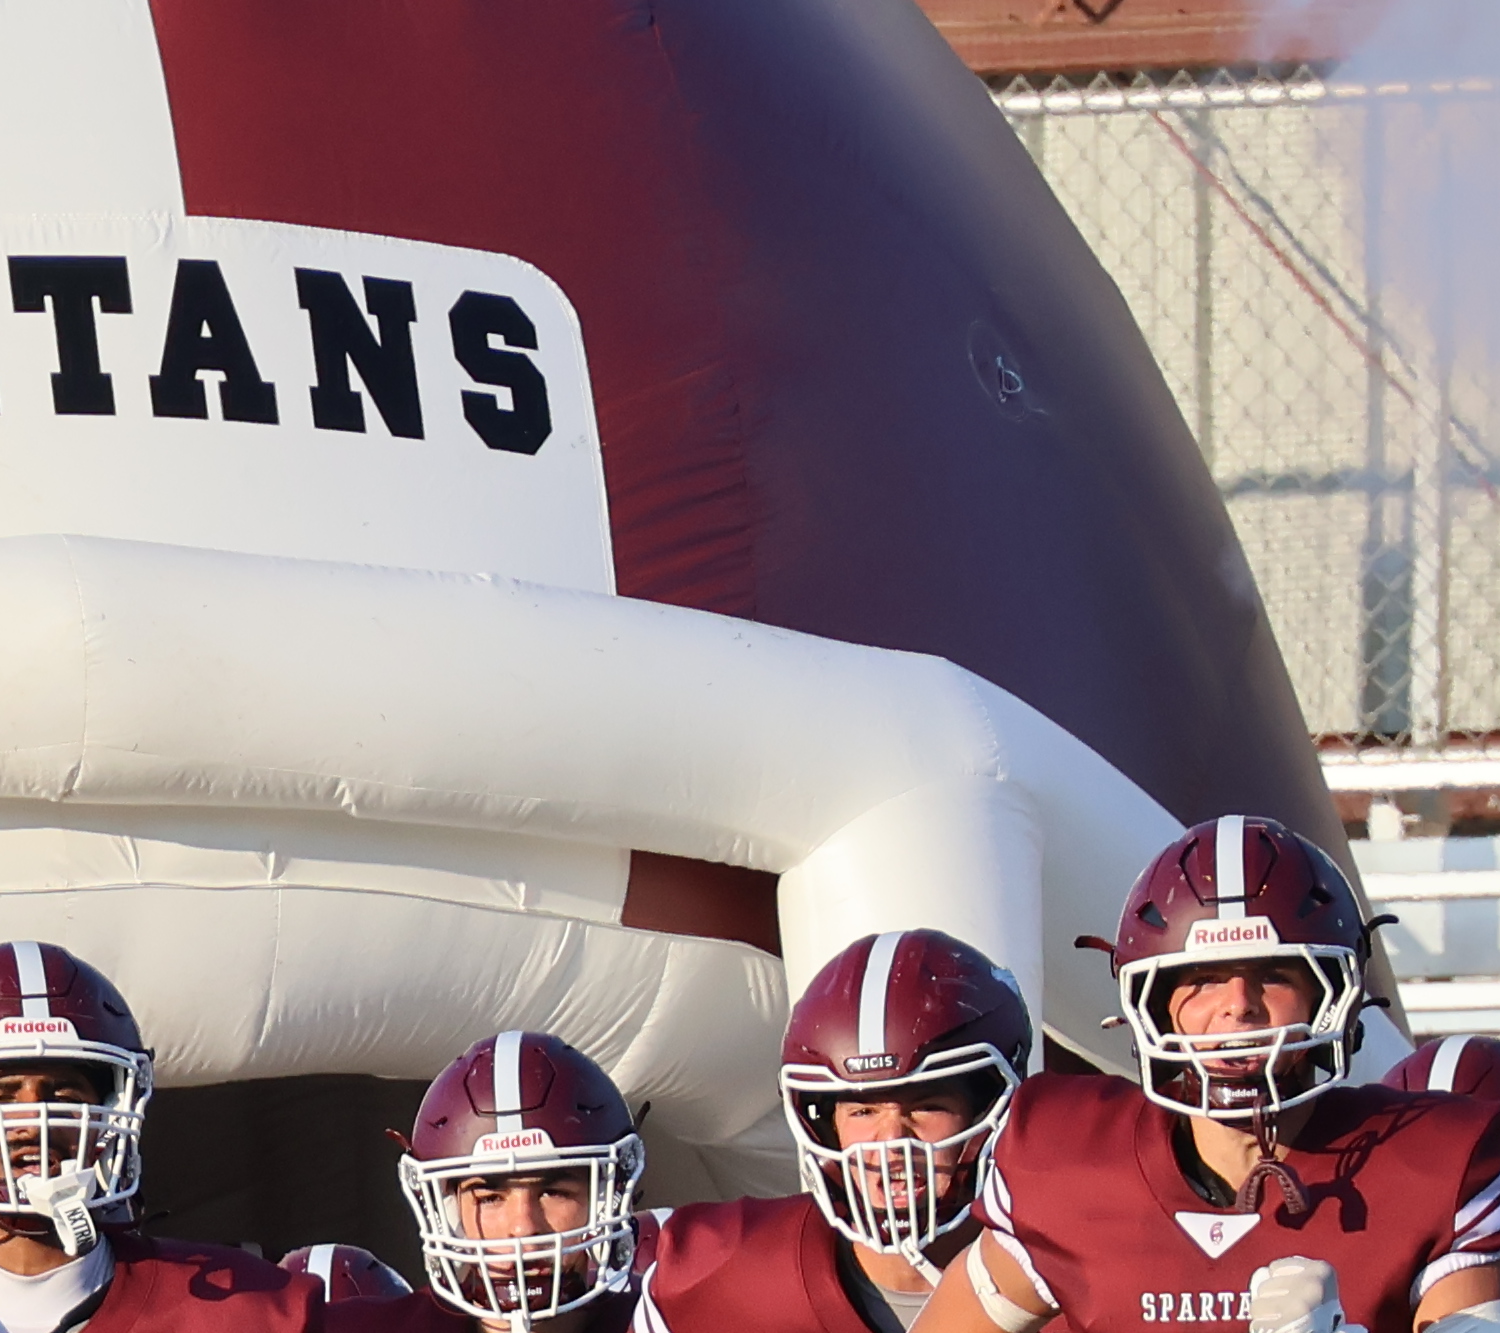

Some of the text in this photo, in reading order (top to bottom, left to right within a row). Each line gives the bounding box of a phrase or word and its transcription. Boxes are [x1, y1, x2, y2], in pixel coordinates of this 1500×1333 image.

[1194, 925, 1269, 944] Riddell
[4, 1020, 68, 1034] Riddell
[483, 1132, 543, 1151] Riddell
[1141, 1292, 1253, 1322] SPARTA
